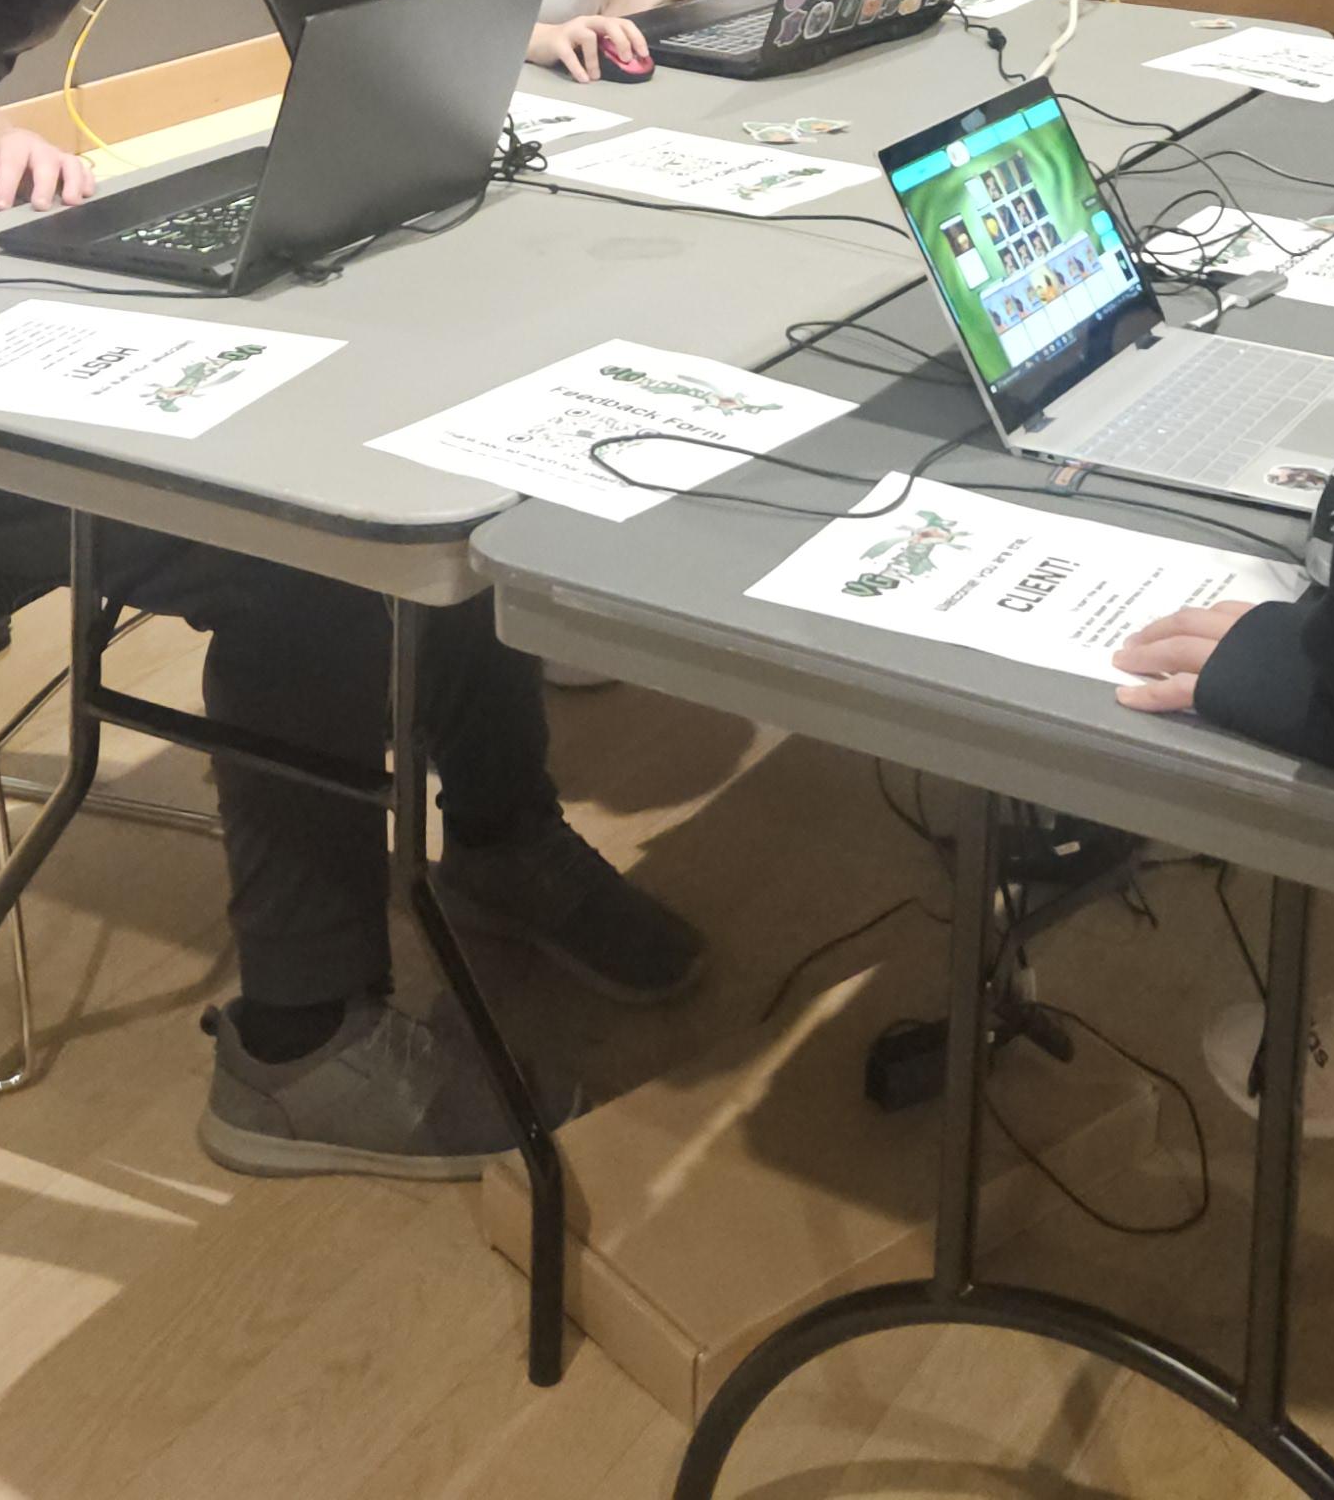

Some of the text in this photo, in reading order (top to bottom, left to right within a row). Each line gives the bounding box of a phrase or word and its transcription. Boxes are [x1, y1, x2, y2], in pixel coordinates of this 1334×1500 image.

[71, 346, 139, 379] HOST!
[550, 385, 727, 441] Feedback Form
[996, 556, 1081, 613] CLIENT!
